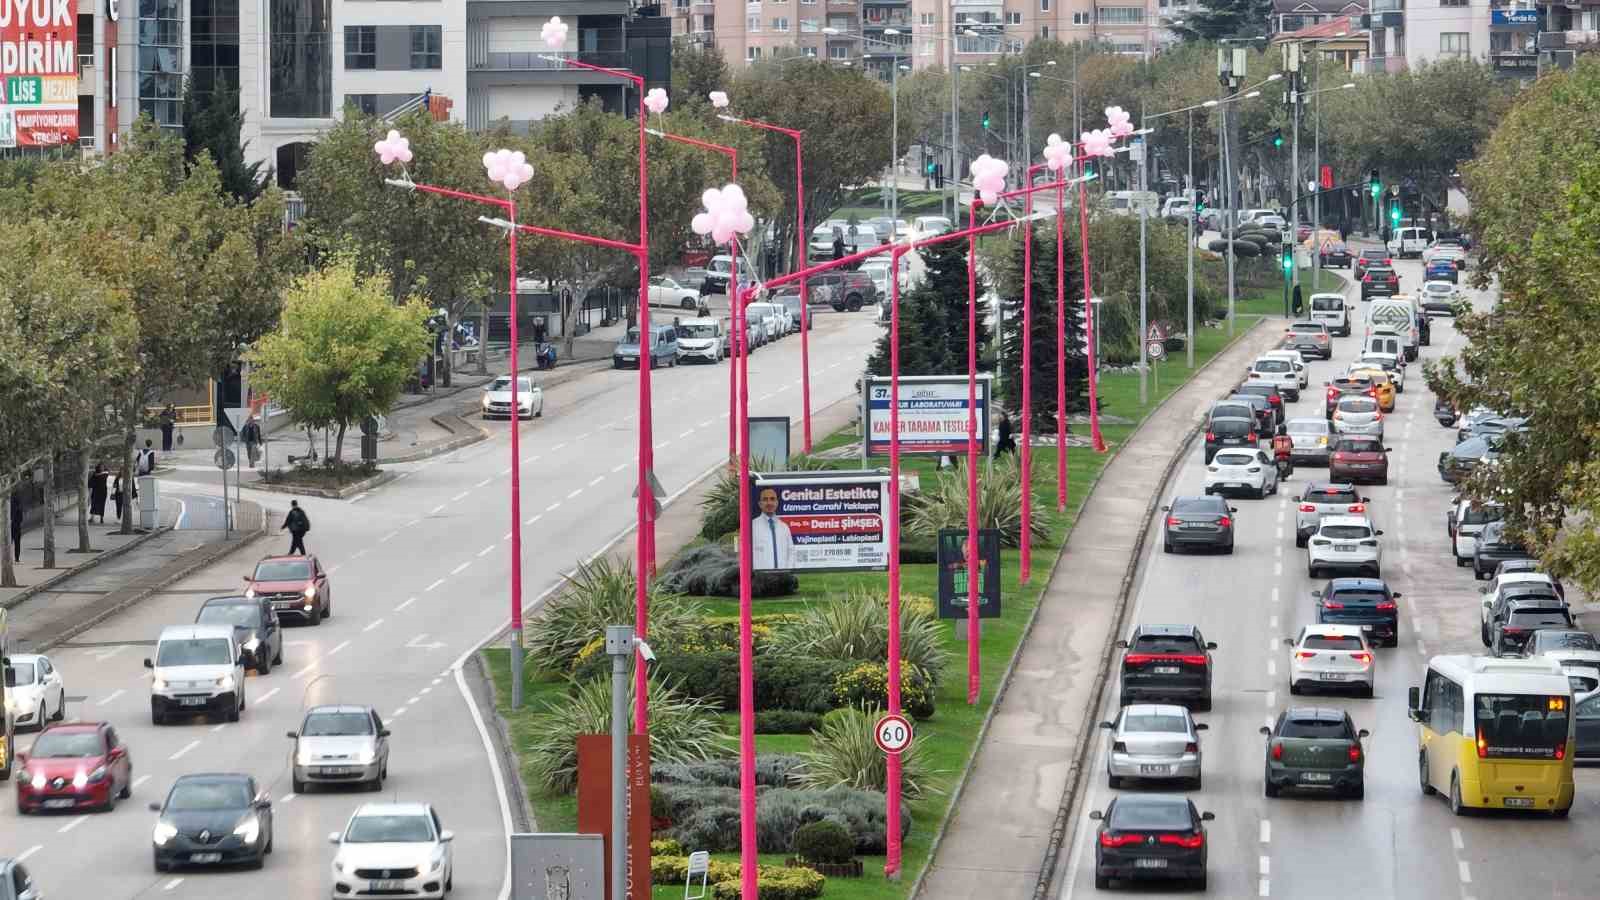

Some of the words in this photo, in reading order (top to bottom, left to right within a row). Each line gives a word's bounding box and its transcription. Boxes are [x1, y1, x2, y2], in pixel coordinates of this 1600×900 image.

[12, 78, 36, 102] LİSE
[907, 420, 941, 433] TARAMA
[781, 488, 823, 501] Genital
[825, 487, 879, 500] Estetikte
[782, 503, 812, 512] Uzman
[811, 518, 840, 529] Deniz
[841, 516, 880, 530] ŞİMŞEK
[882, 726, 904, 742] 60
